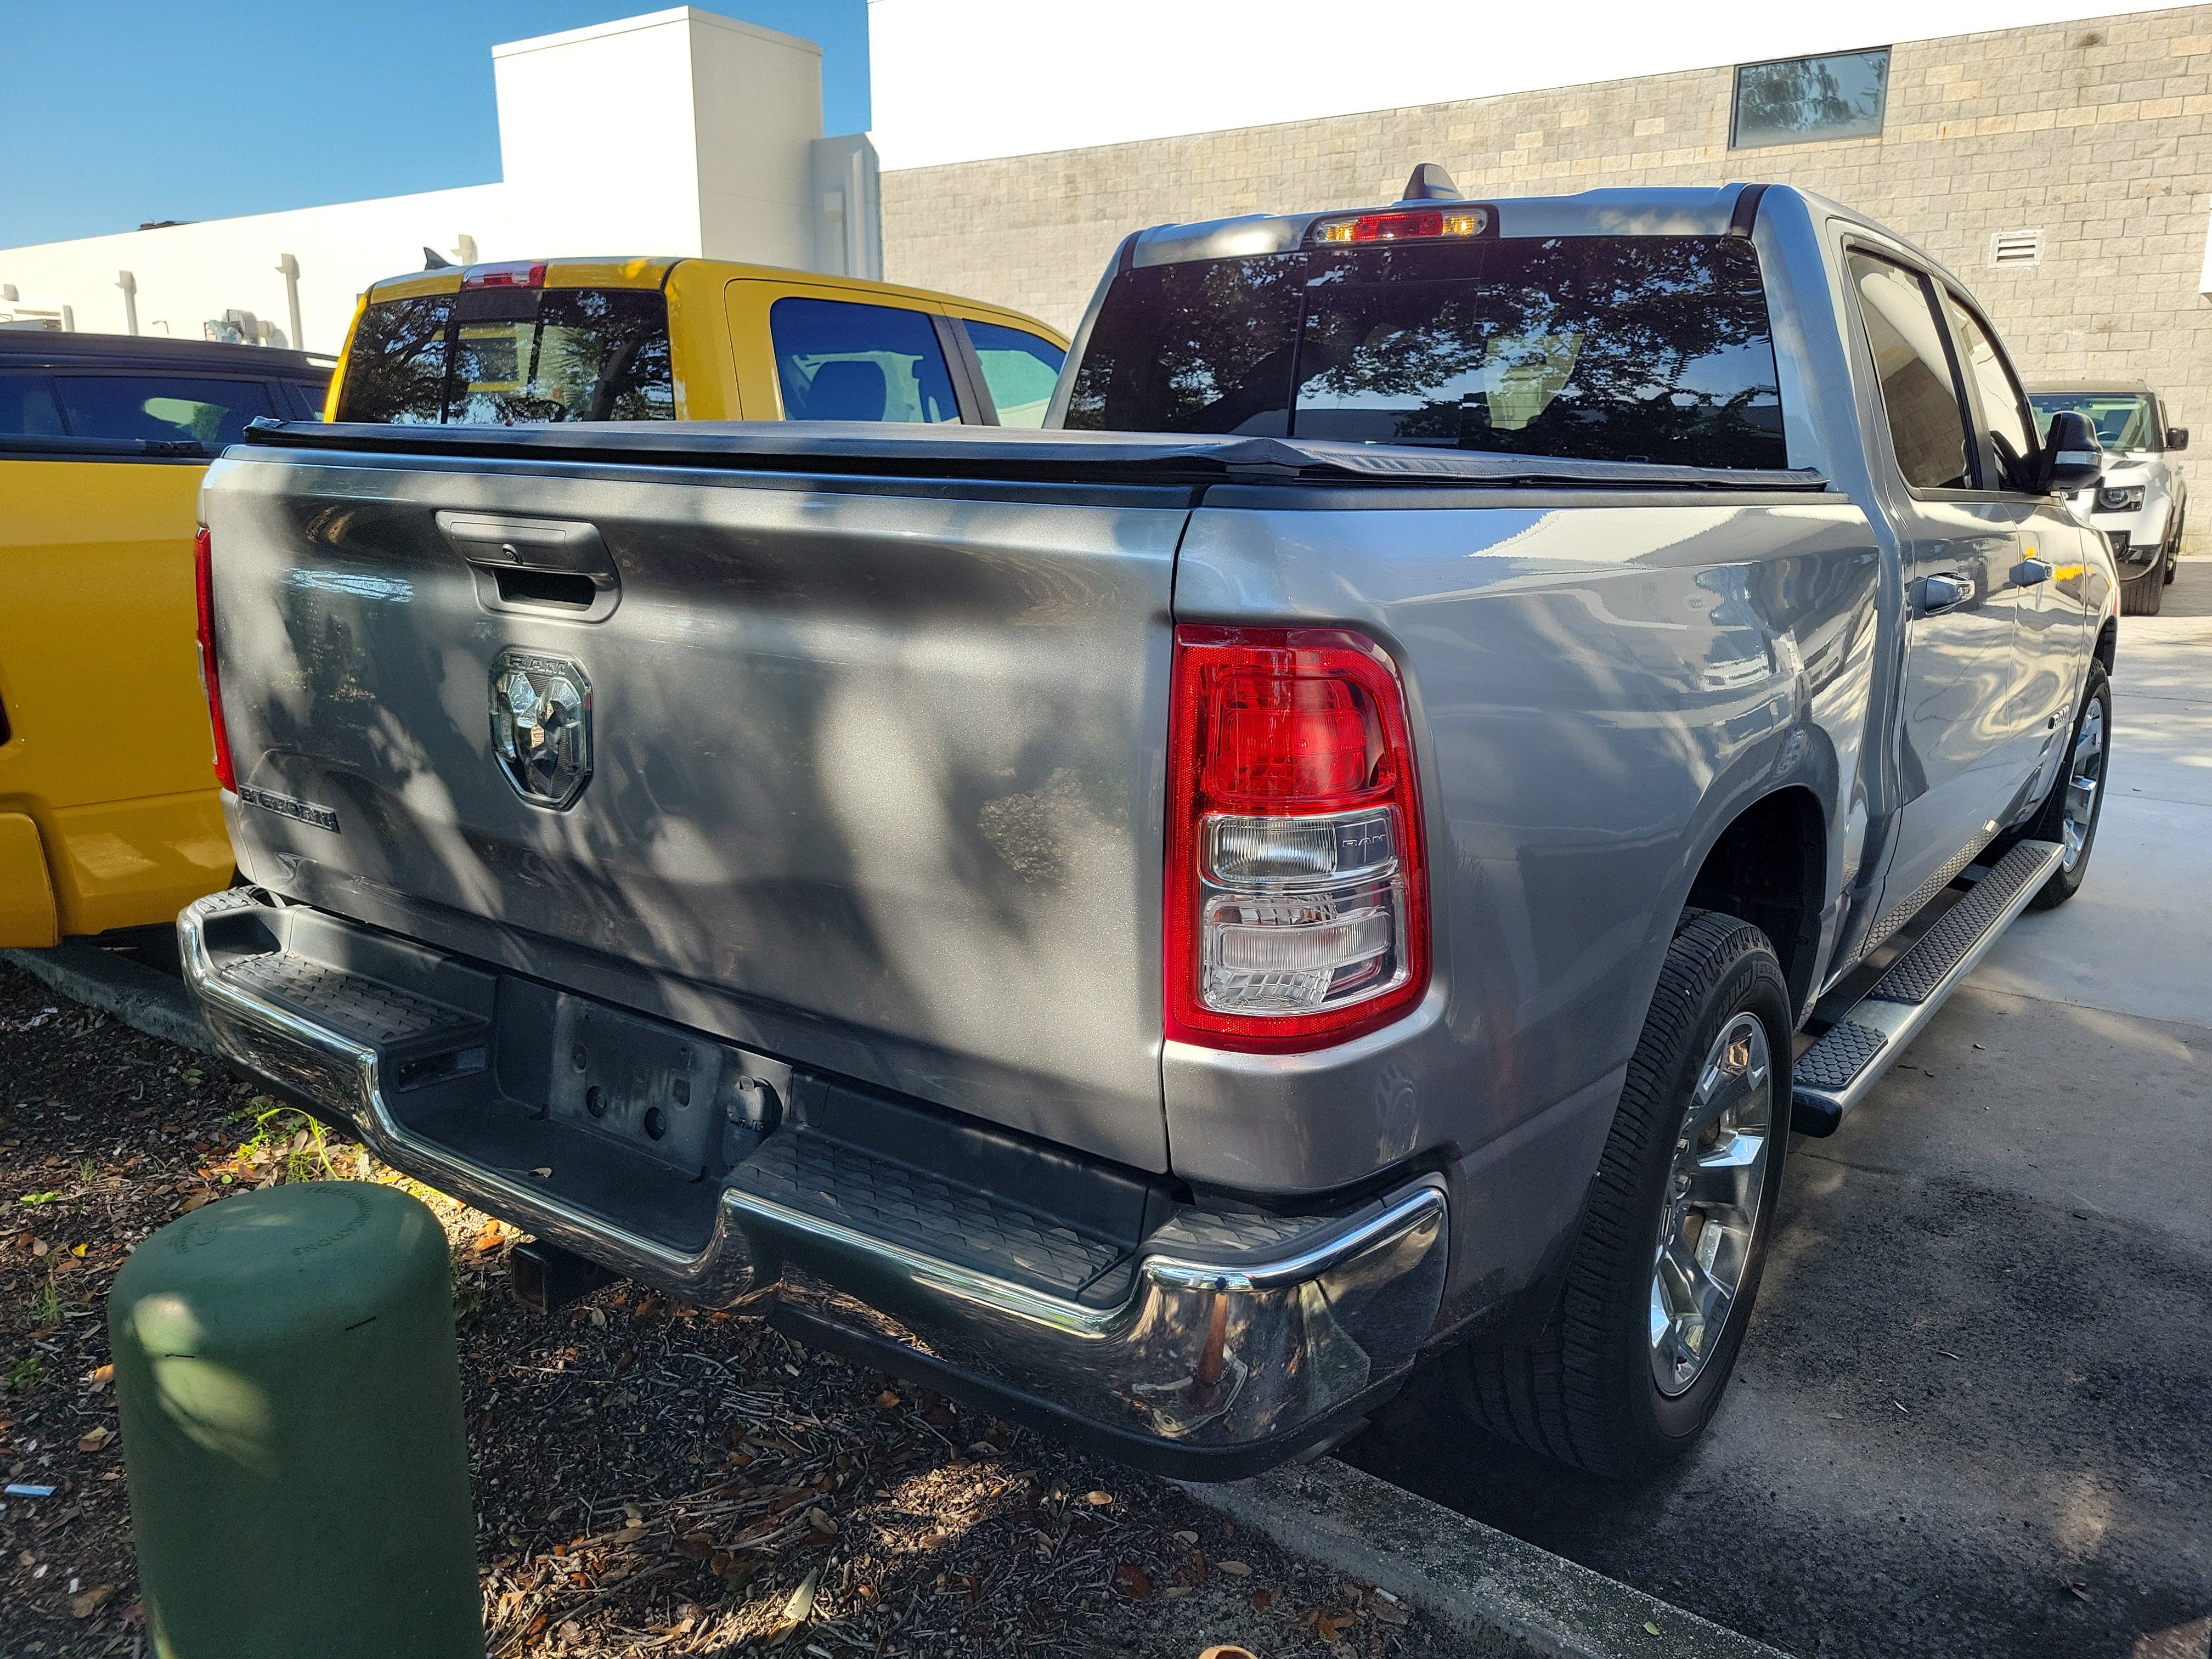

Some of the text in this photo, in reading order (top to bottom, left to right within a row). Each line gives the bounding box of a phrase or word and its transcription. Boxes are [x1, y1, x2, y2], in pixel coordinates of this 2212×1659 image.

[506, 654, 566, 675] RAM
[1342, 834, 1386, 848] RAM
[1702, 969, 1752, 1057] MICHELIN
[291, 1187, 373, 1256] TELECOMMUNICATIONS
